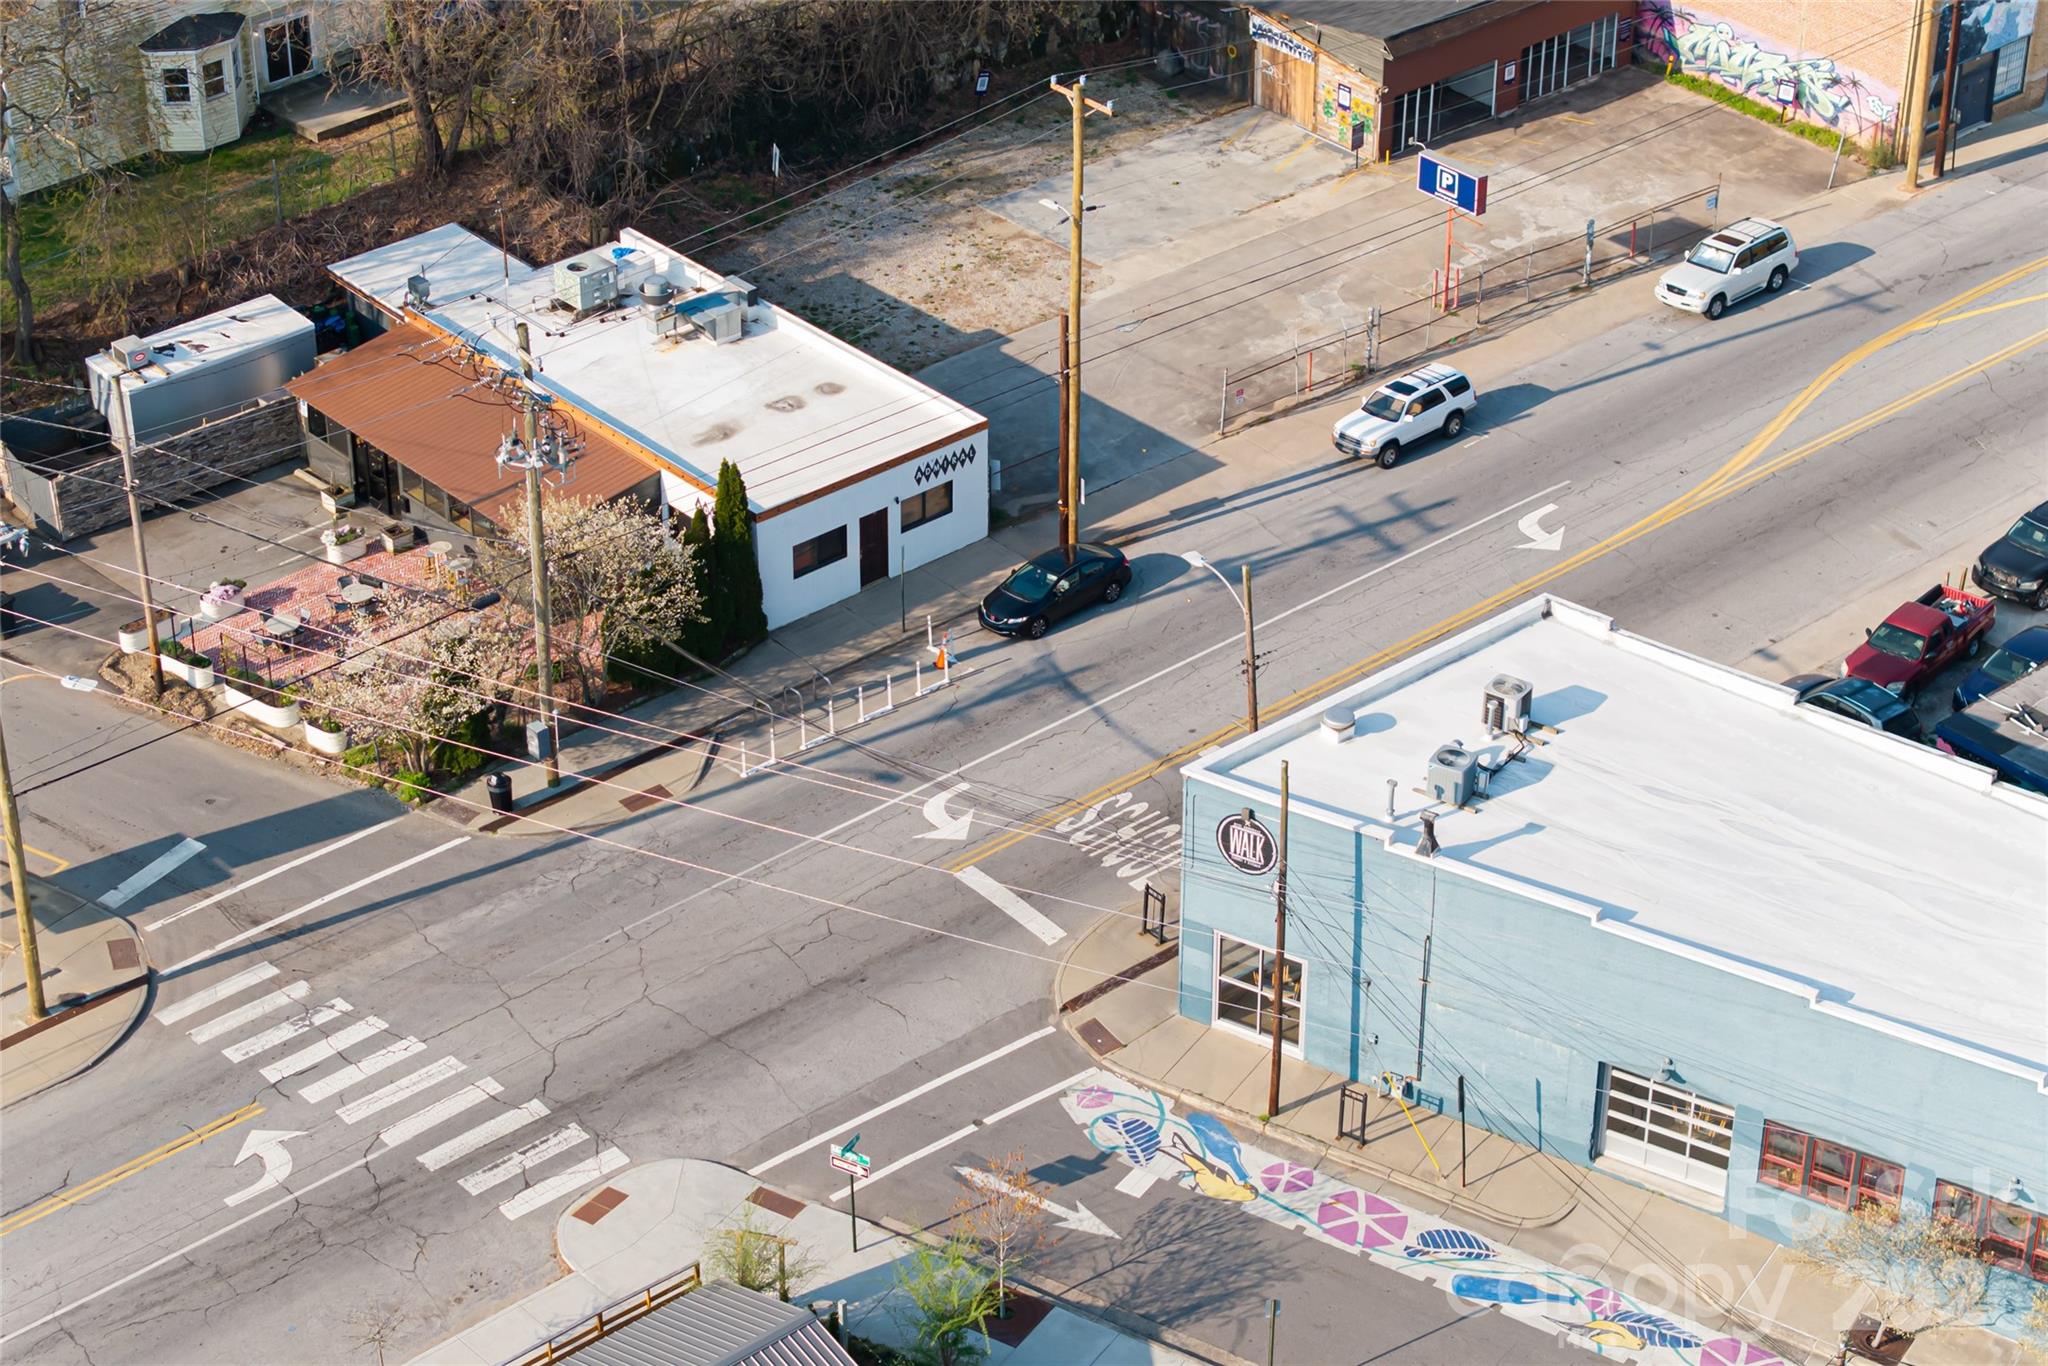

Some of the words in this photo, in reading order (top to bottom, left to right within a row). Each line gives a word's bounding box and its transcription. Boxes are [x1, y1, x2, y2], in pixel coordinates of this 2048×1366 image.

[1441, 171, 1454, 189] P
[915, 447, 975, 483] ADMIRAL
[1229, 825, 1266, 866] WALK
